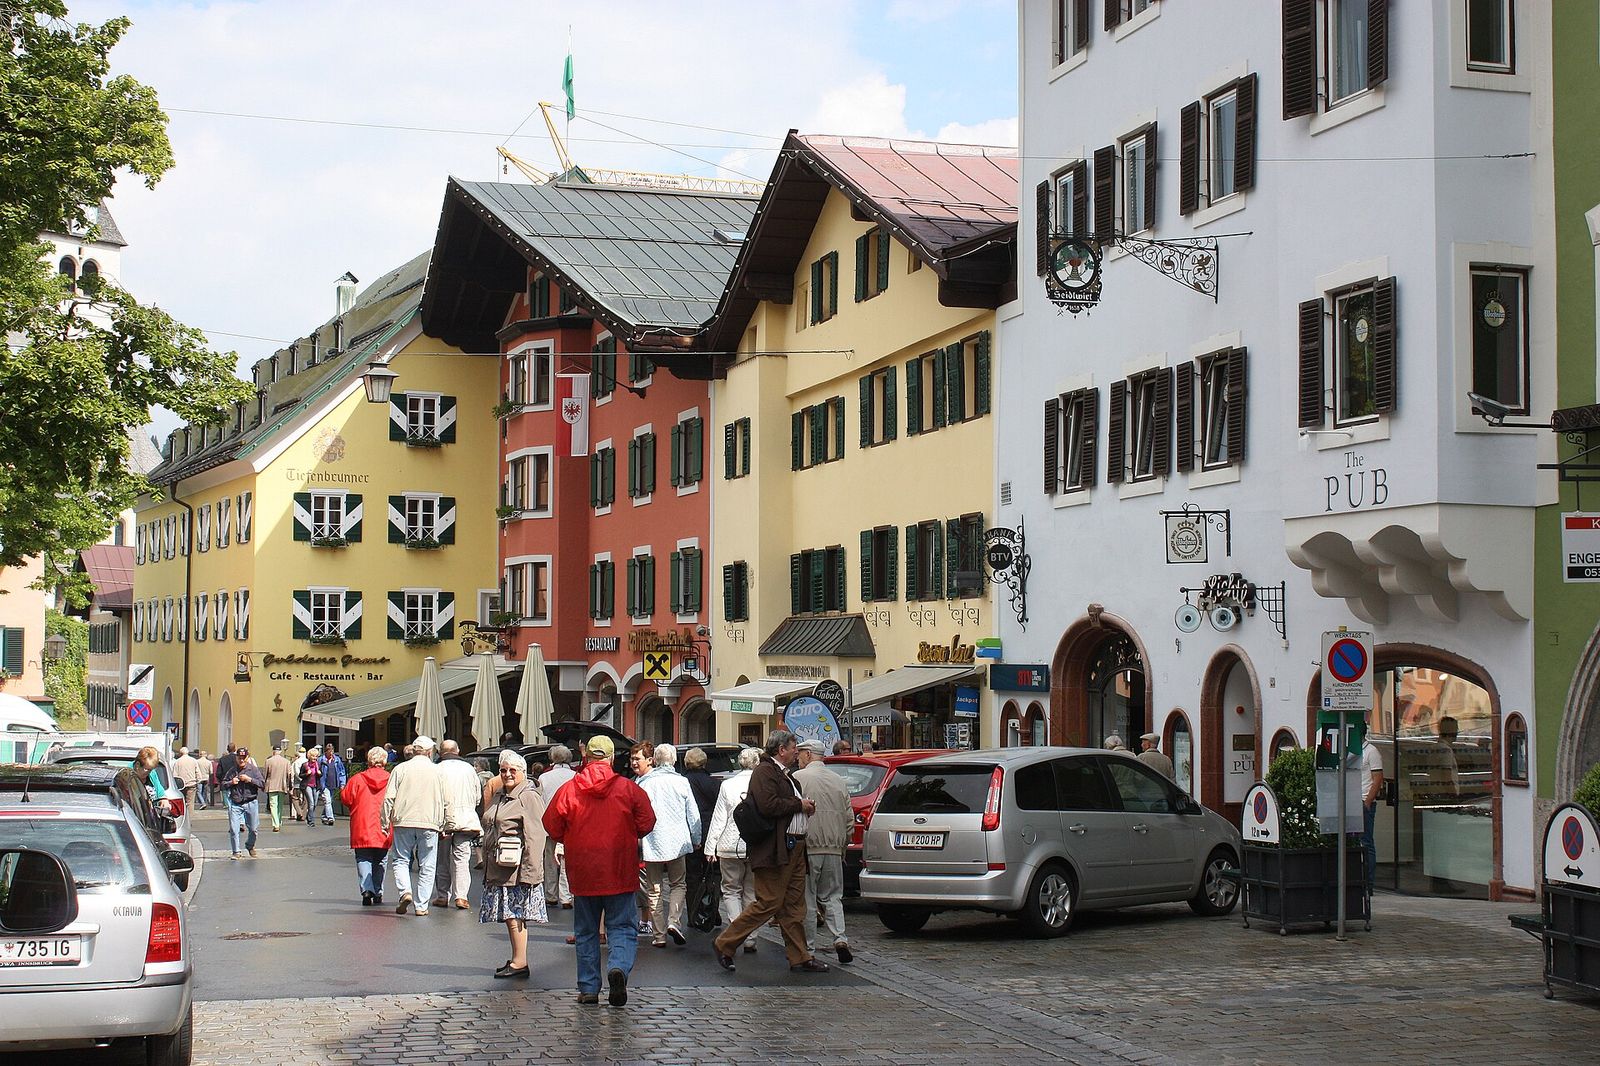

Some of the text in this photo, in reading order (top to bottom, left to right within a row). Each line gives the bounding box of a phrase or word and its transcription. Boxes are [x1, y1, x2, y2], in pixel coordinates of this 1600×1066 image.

[1344, 451, 1364, 468] The
[286, 468, 369, 484] Tiefenbrunner
[1323, 468, 1389, 512] PUB
[990, 552, 1010, 562] BTV
[585, 637, 618, 652] RESTAURANT
[269, 672, 384, 680] Cafe Restaurant Bar
[789, 703, 822, 718] LOTTO
[840, 714, 891, 725] TAAKTRAFIK
[902, 835, 941, 845] LL 200 HP
[112, 906, 142, 917] OCTAVIA
[17, 940, 70, 957] 735 IG
